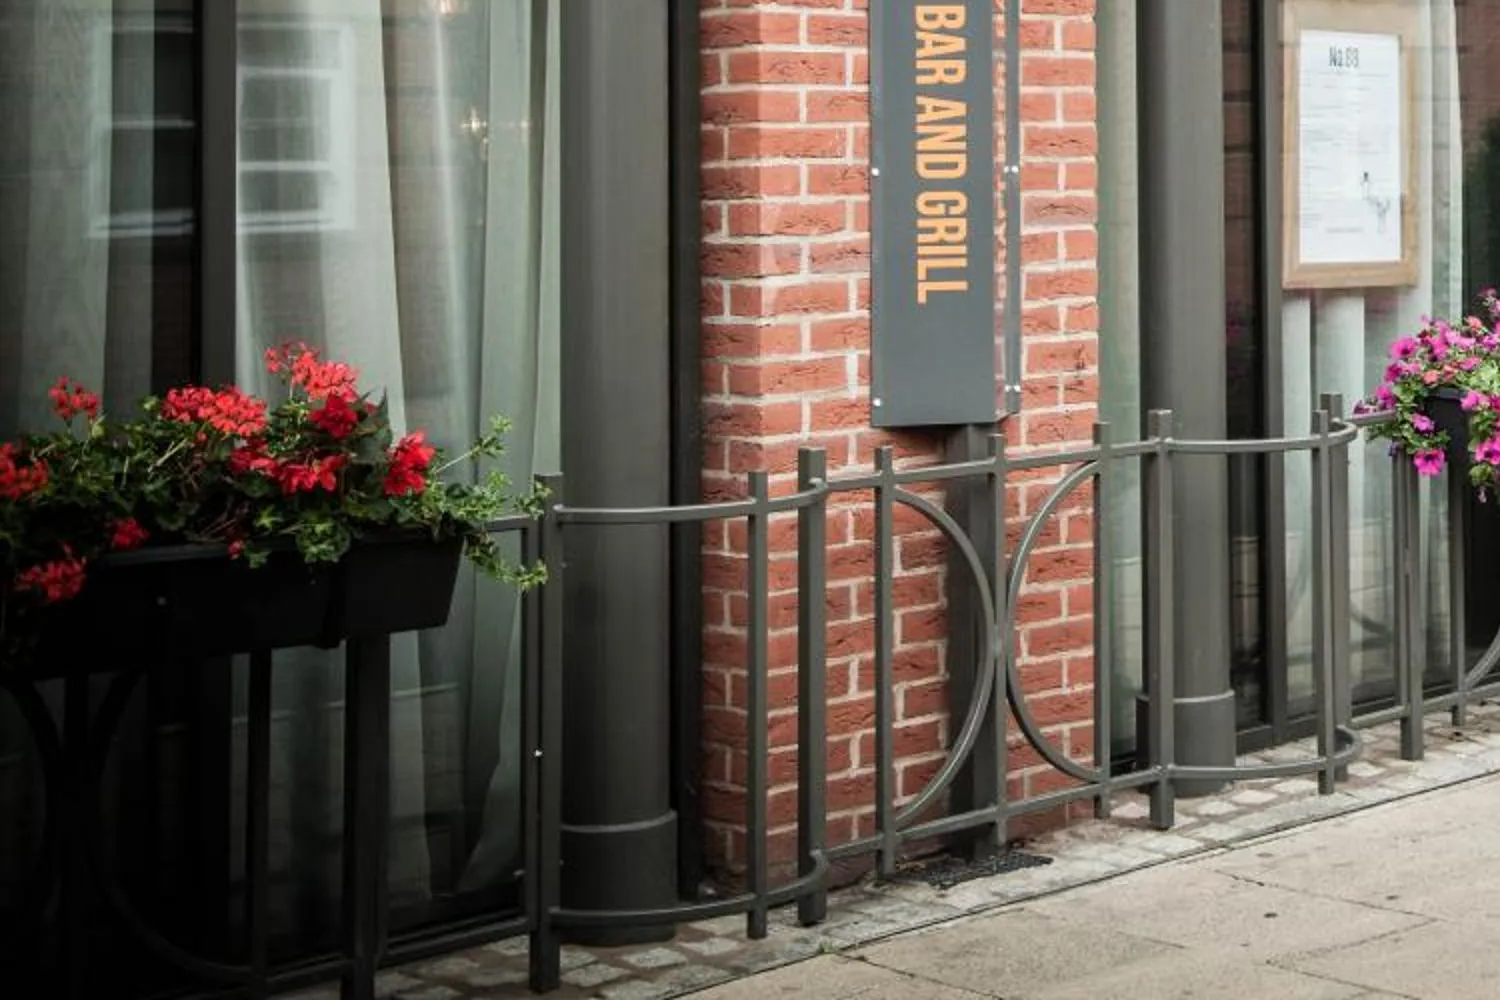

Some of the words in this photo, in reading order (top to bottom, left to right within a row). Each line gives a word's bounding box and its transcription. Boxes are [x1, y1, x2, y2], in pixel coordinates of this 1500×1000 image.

[914, 4, 967, 85] BAR
[914, 96, 968, 180] AND
[915, 191, 969, 304] GRILL
